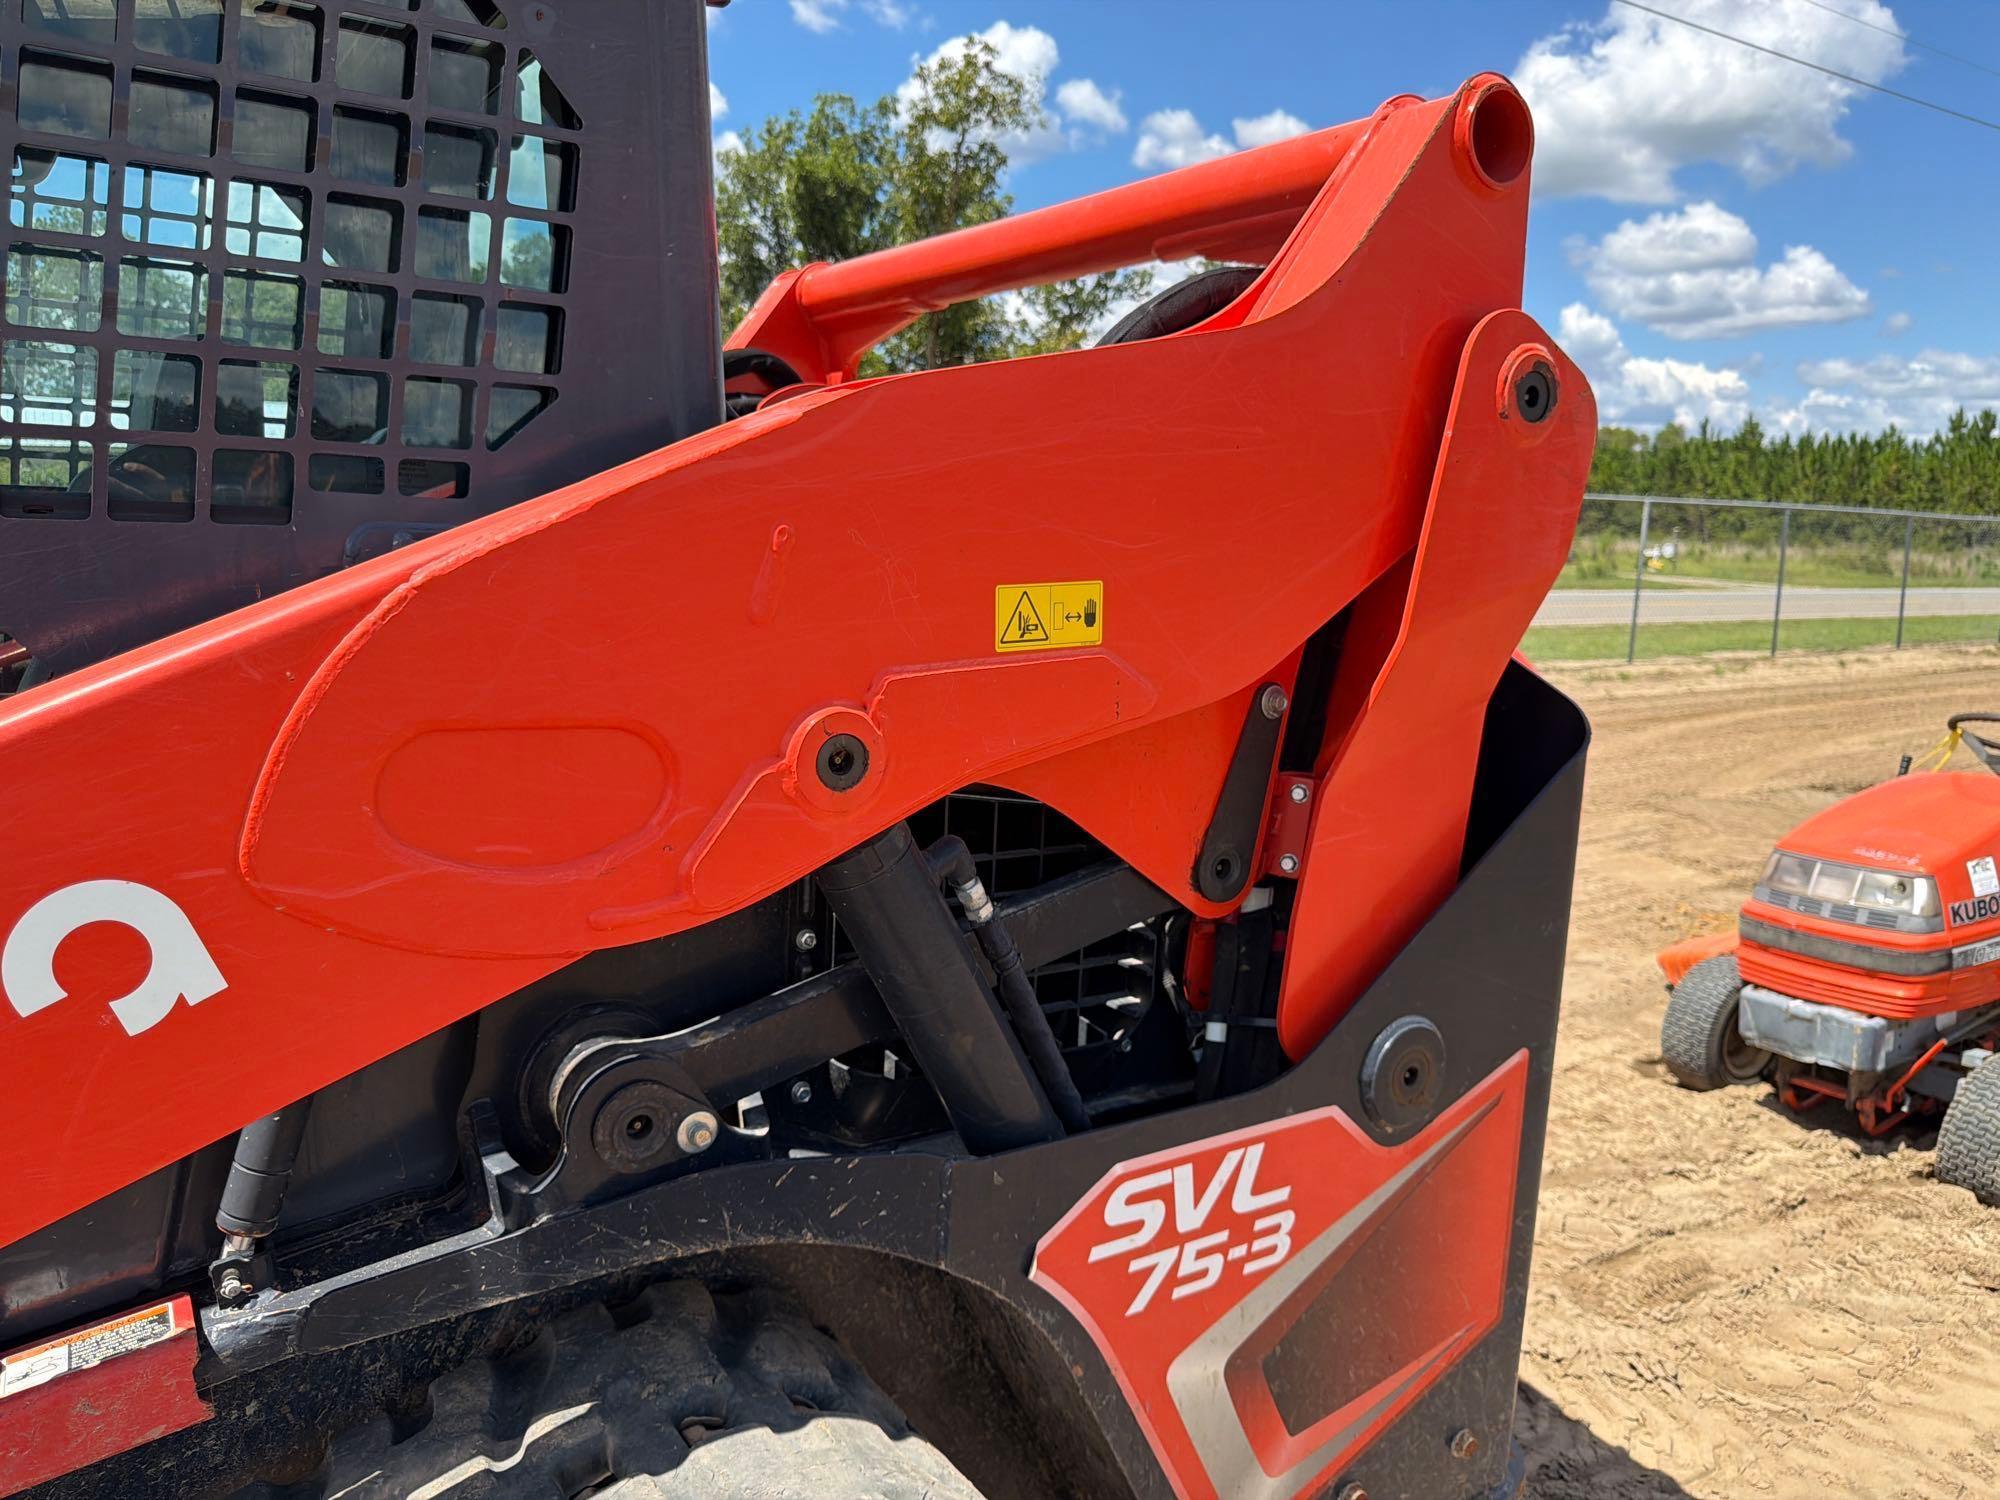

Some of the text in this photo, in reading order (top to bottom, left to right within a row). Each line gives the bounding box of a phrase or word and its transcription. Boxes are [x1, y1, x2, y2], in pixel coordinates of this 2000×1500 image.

[1951, 895, 2000, 924] KUBO
[1088, 1141, 1292, 1264] SVL
[1124, 1209, 1296, 1318] 75-3
